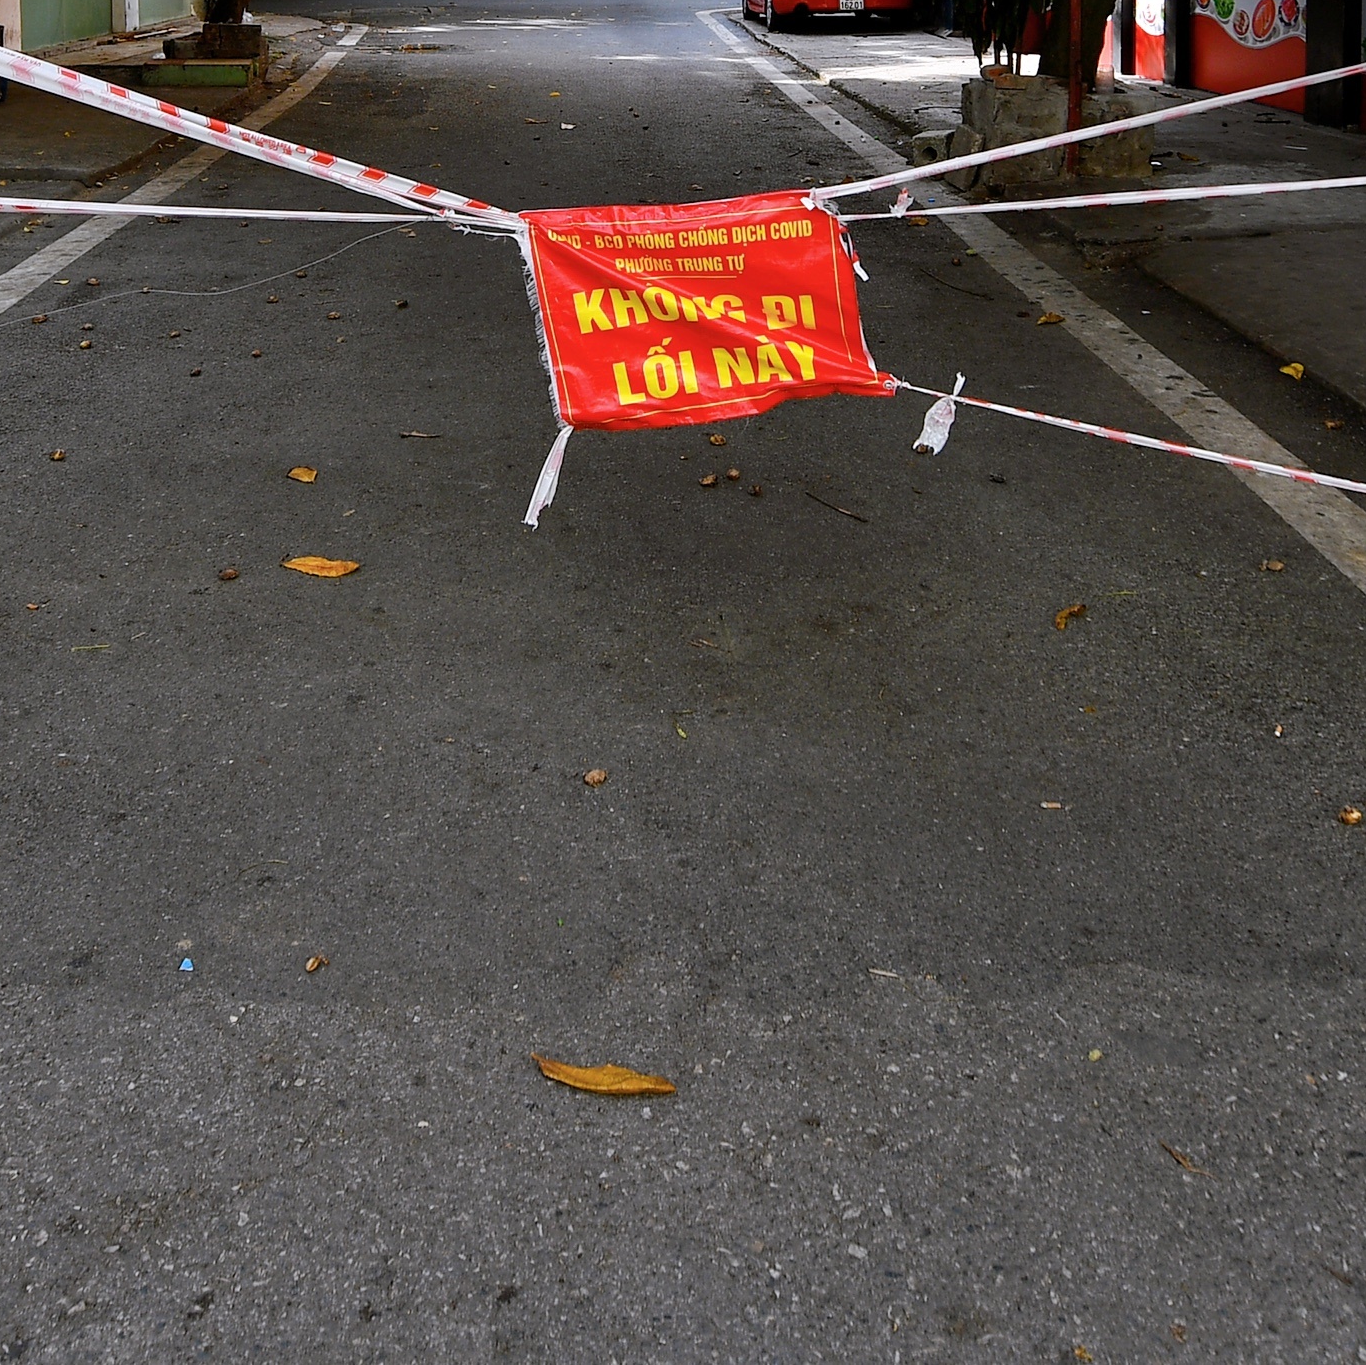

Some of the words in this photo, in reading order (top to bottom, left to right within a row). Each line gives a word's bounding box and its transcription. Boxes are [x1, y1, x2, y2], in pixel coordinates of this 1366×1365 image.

[628, 229, 675, 250] PHÒNG
[679, 224, 728, 249] CHỐNG
[733, 225, 767, 247] DỊCH
[770, 219, 813, 240] COVID
[615, 255, 673, 275] PHƯỜNG
[676, 255, 723, 272] TRUNG
[727, 253, 745, 275] TỰ
[573, 283, 747, 335] KHÔNG
[761, 294, 817, 331] ĐI
[613, 337, 699, 406] LỐI
[713, 336, 817, 389] NÀY
